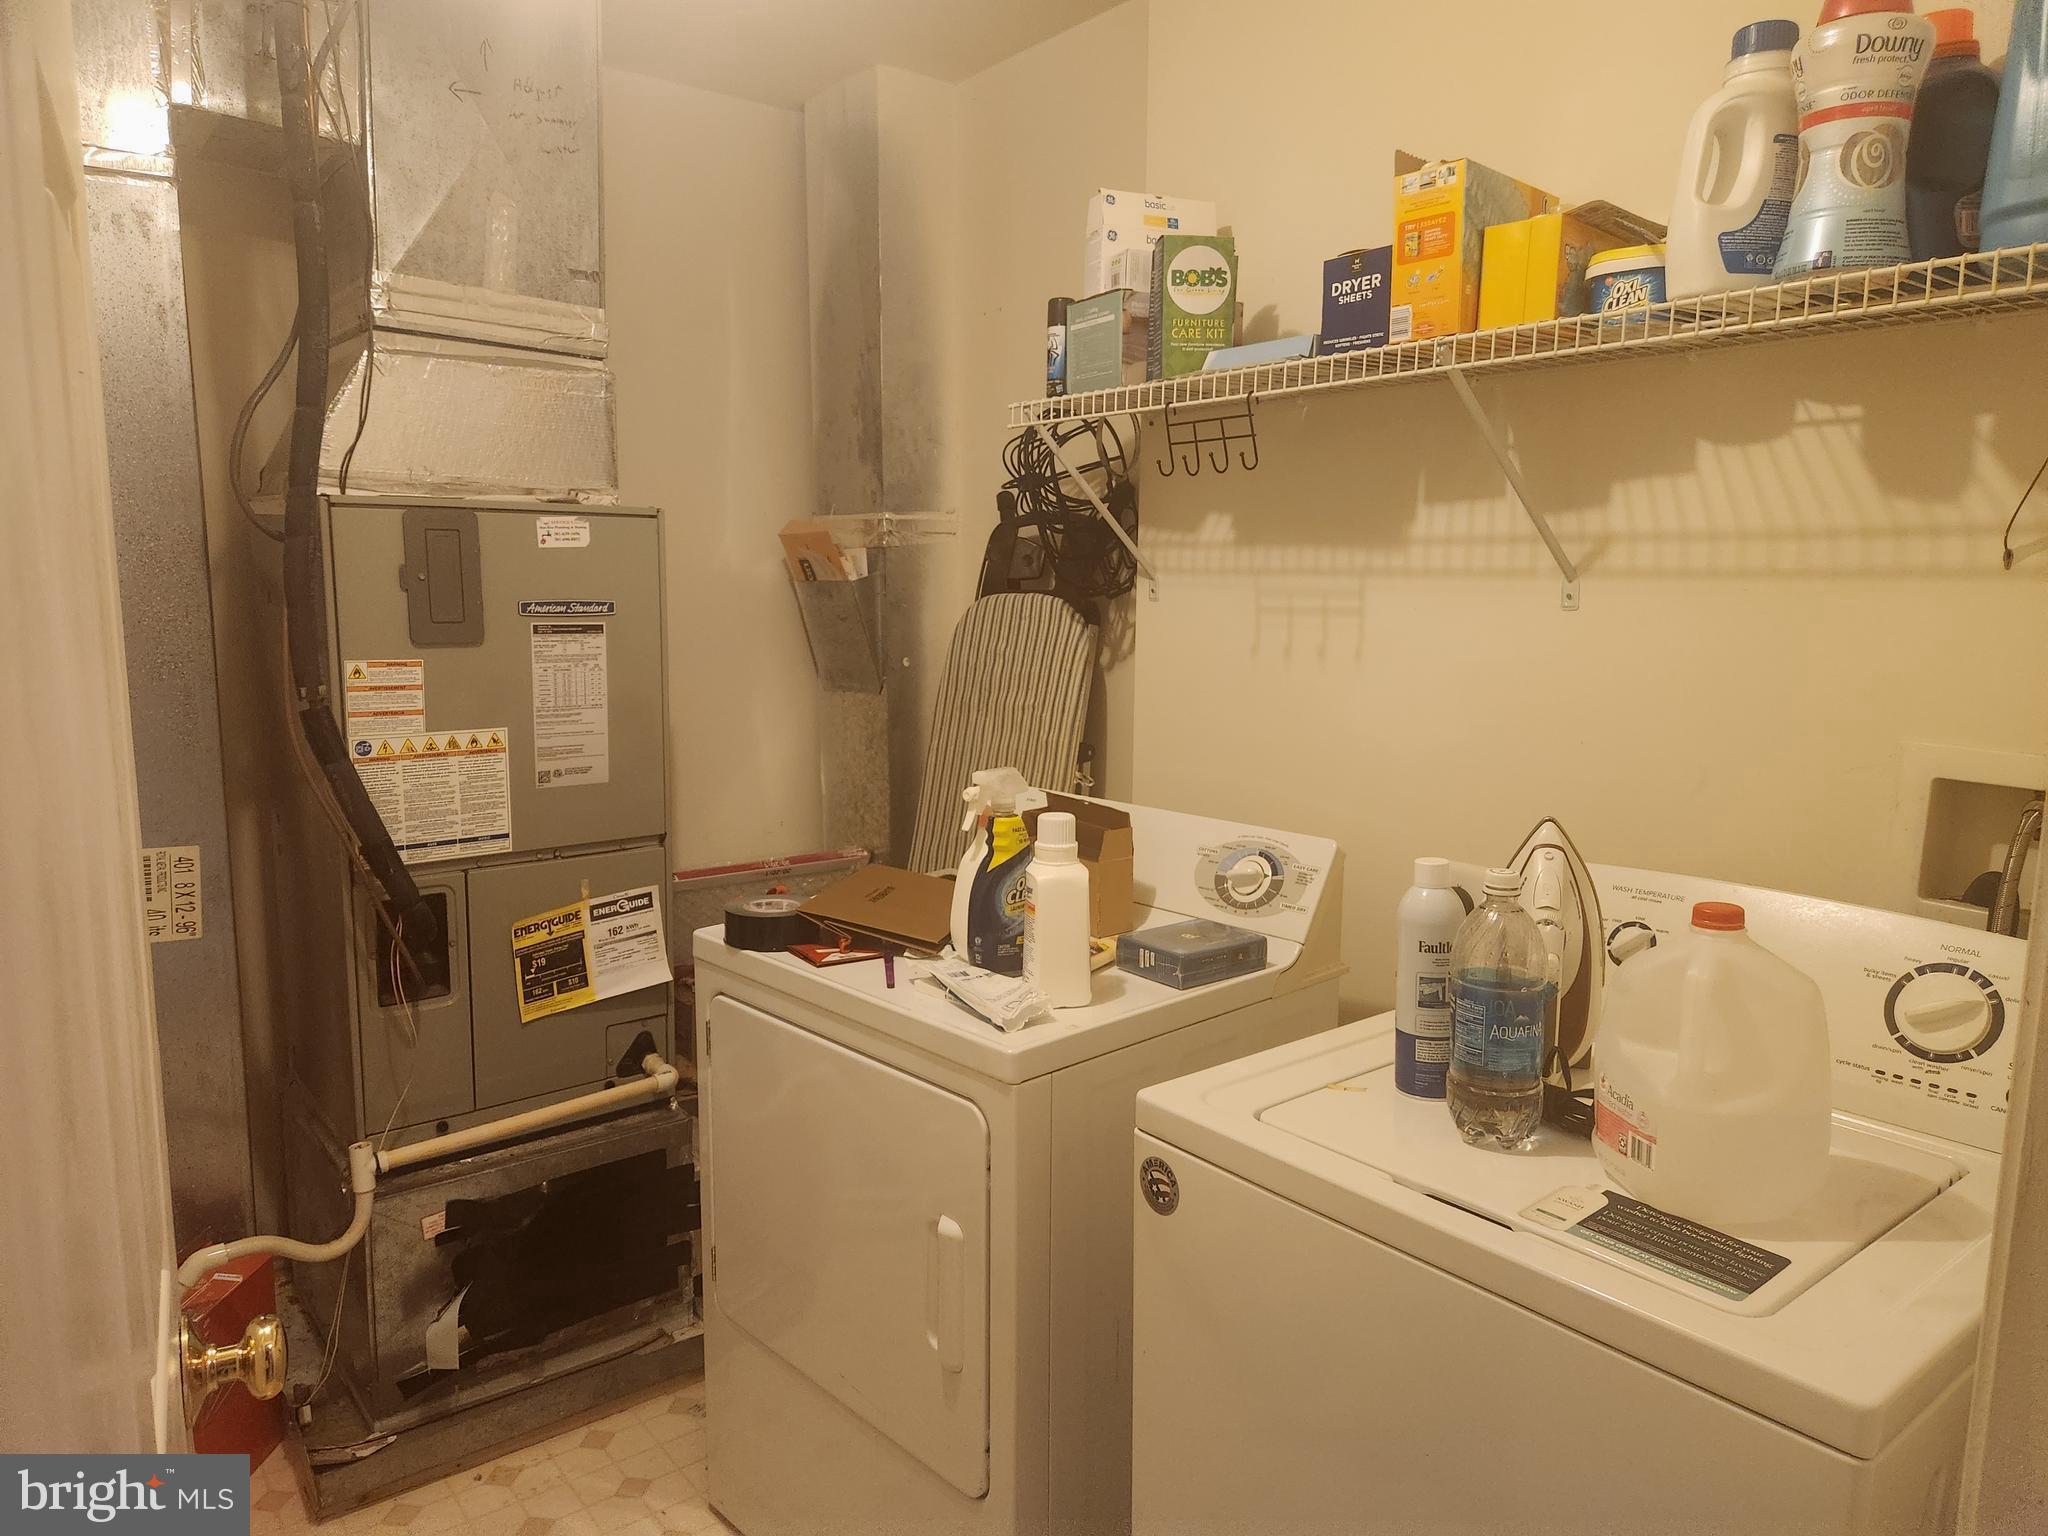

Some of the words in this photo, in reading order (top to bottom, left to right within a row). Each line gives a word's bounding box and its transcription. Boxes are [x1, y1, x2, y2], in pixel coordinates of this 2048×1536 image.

[1856, 33, 1924, 62] Downy
[1852, 54, 1876, 65] fresh
[1144, 199, 1166, 210] basic
[1171, 267, 1228, 287] BOB'S
[1331, 273, 1382, 297] DRYER
[1611, 278, 1640, 299] OXI
[1338, 290, 1373, 305] SHEETS
[1172, 318, 1225, 328] FURNITURE
[1171, 328, 1201, 339] CARE
[1206, 328, 1225, 339] KIT
[526, 602, 566, 613] American
[567, 602, 610, 613] Standard
[173, 856, 195, 874] 401
[1612, 883, 1633, 893] WASH
[1006, 889, 1026, 905] CLE
[593, 897, 650, 917] ENERGUIDE
[607, 925, 624, 937] 162
[1940, 943, 1982, 958] NORMAL
[531, 956, 546, 968] $19
[1607, 1084, 1634, 1111] Acadia
[1990, 1104, 2007, 1114] CAN
